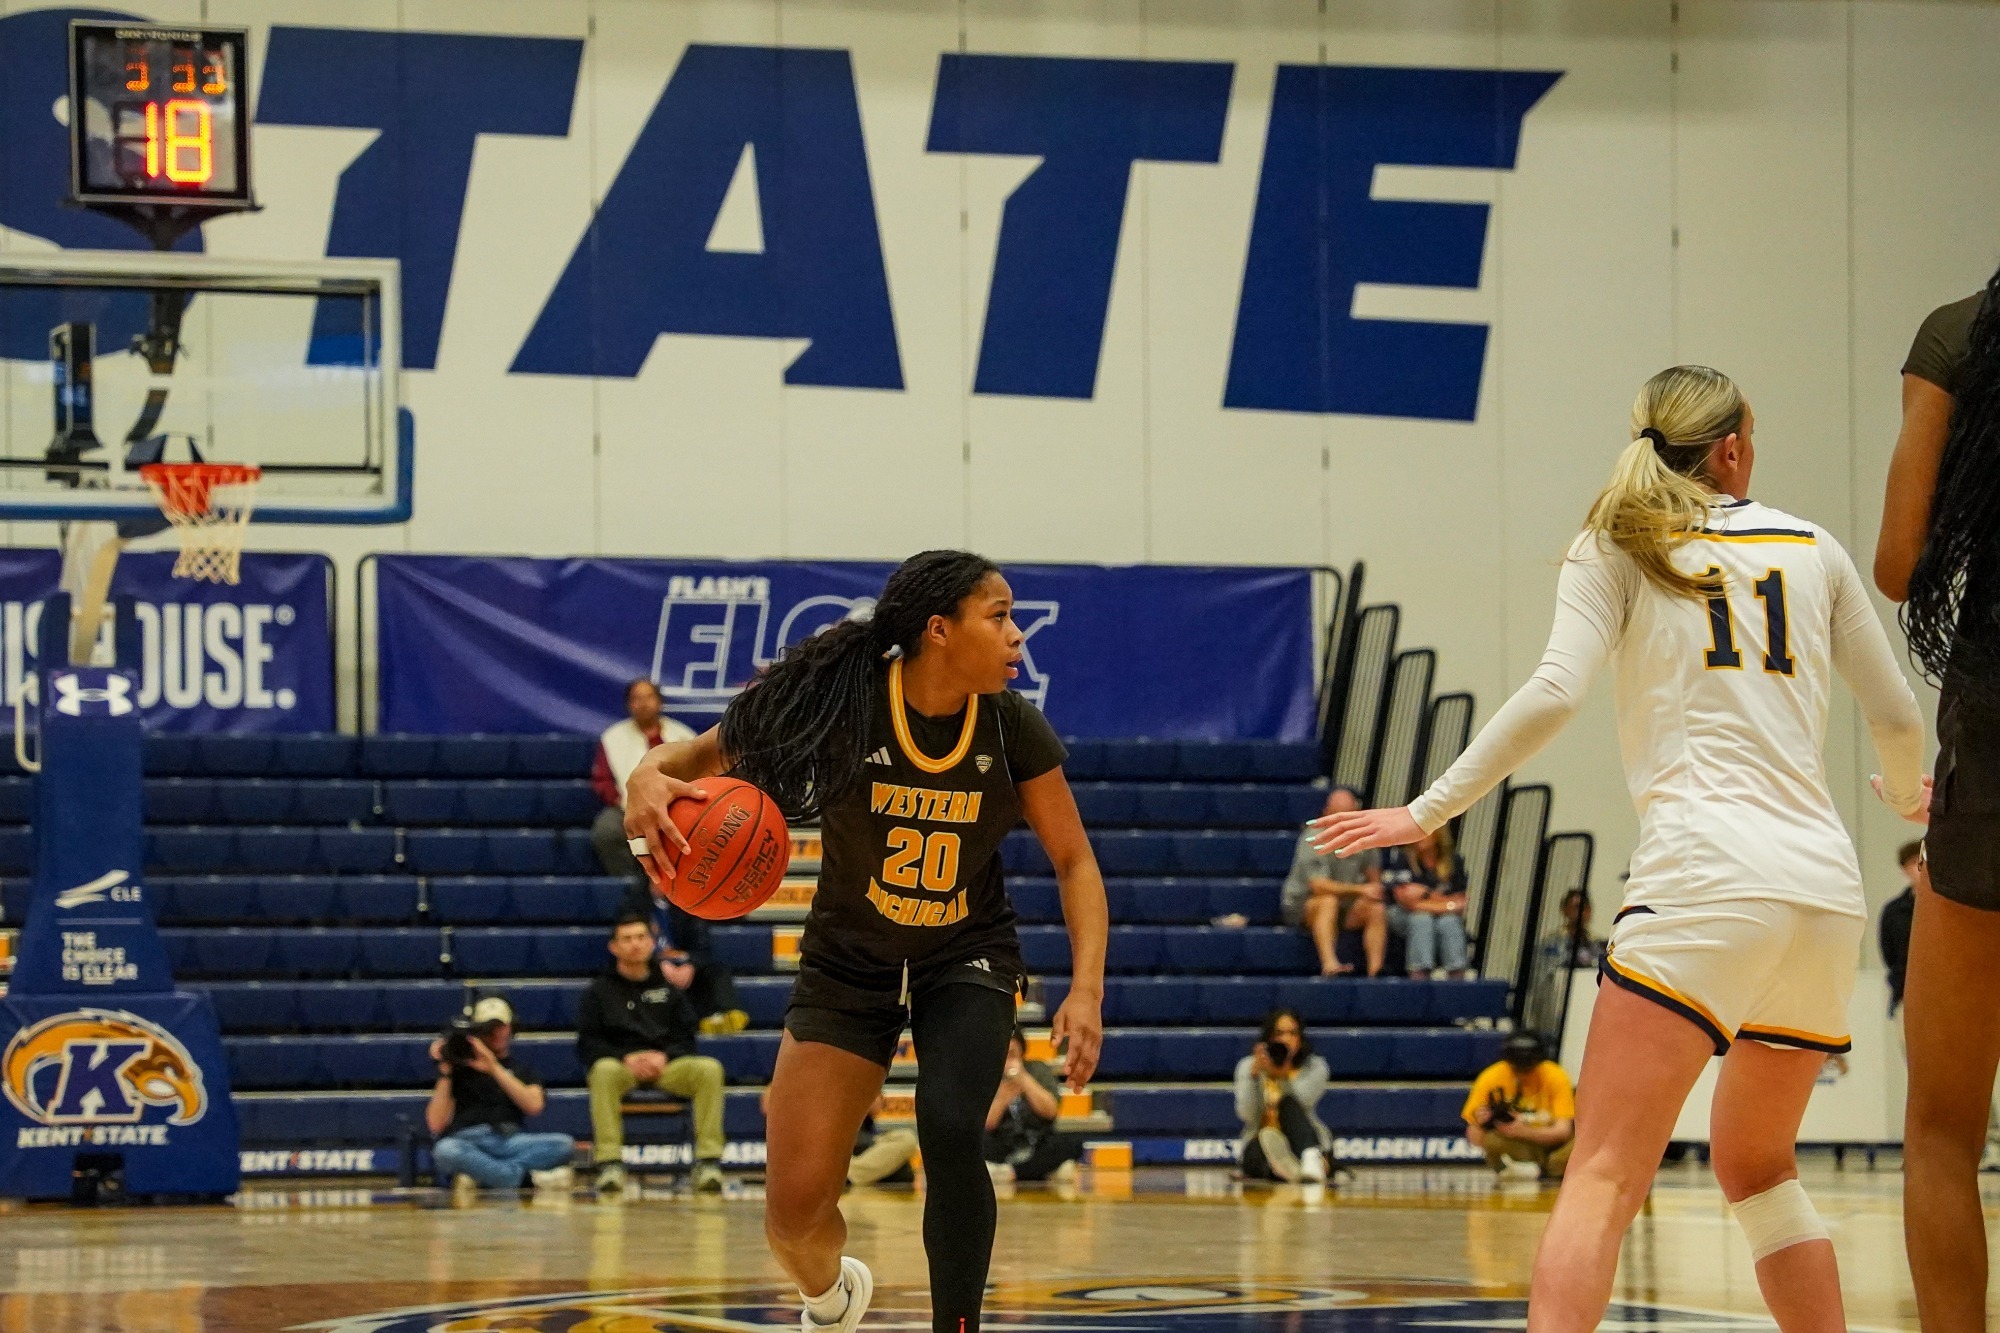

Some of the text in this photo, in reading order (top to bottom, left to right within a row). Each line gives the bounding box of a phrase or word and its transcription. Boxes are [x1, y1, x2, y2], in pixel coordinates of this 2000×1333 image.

[145, 99, 213, 183] 18
[668, 575, 771, 599] FLASH'S
[1695, 565, 1795, 677] 11
[871, 781, 983, 823] WESTERN
[686, 802, 753, 890] SPALDING
[882, 826, 961, 892] 20
[722, 828, 775, 903] LEGACY
[111, 886, 142, 902] CLE
[61, 932, 97, 947] THE
[17, 1125, 170, 1149] KENT STATE
[1332, 1138, 1424, 1160] GOLDEN
[238, 1150, 374, 1172] ENT STATE
